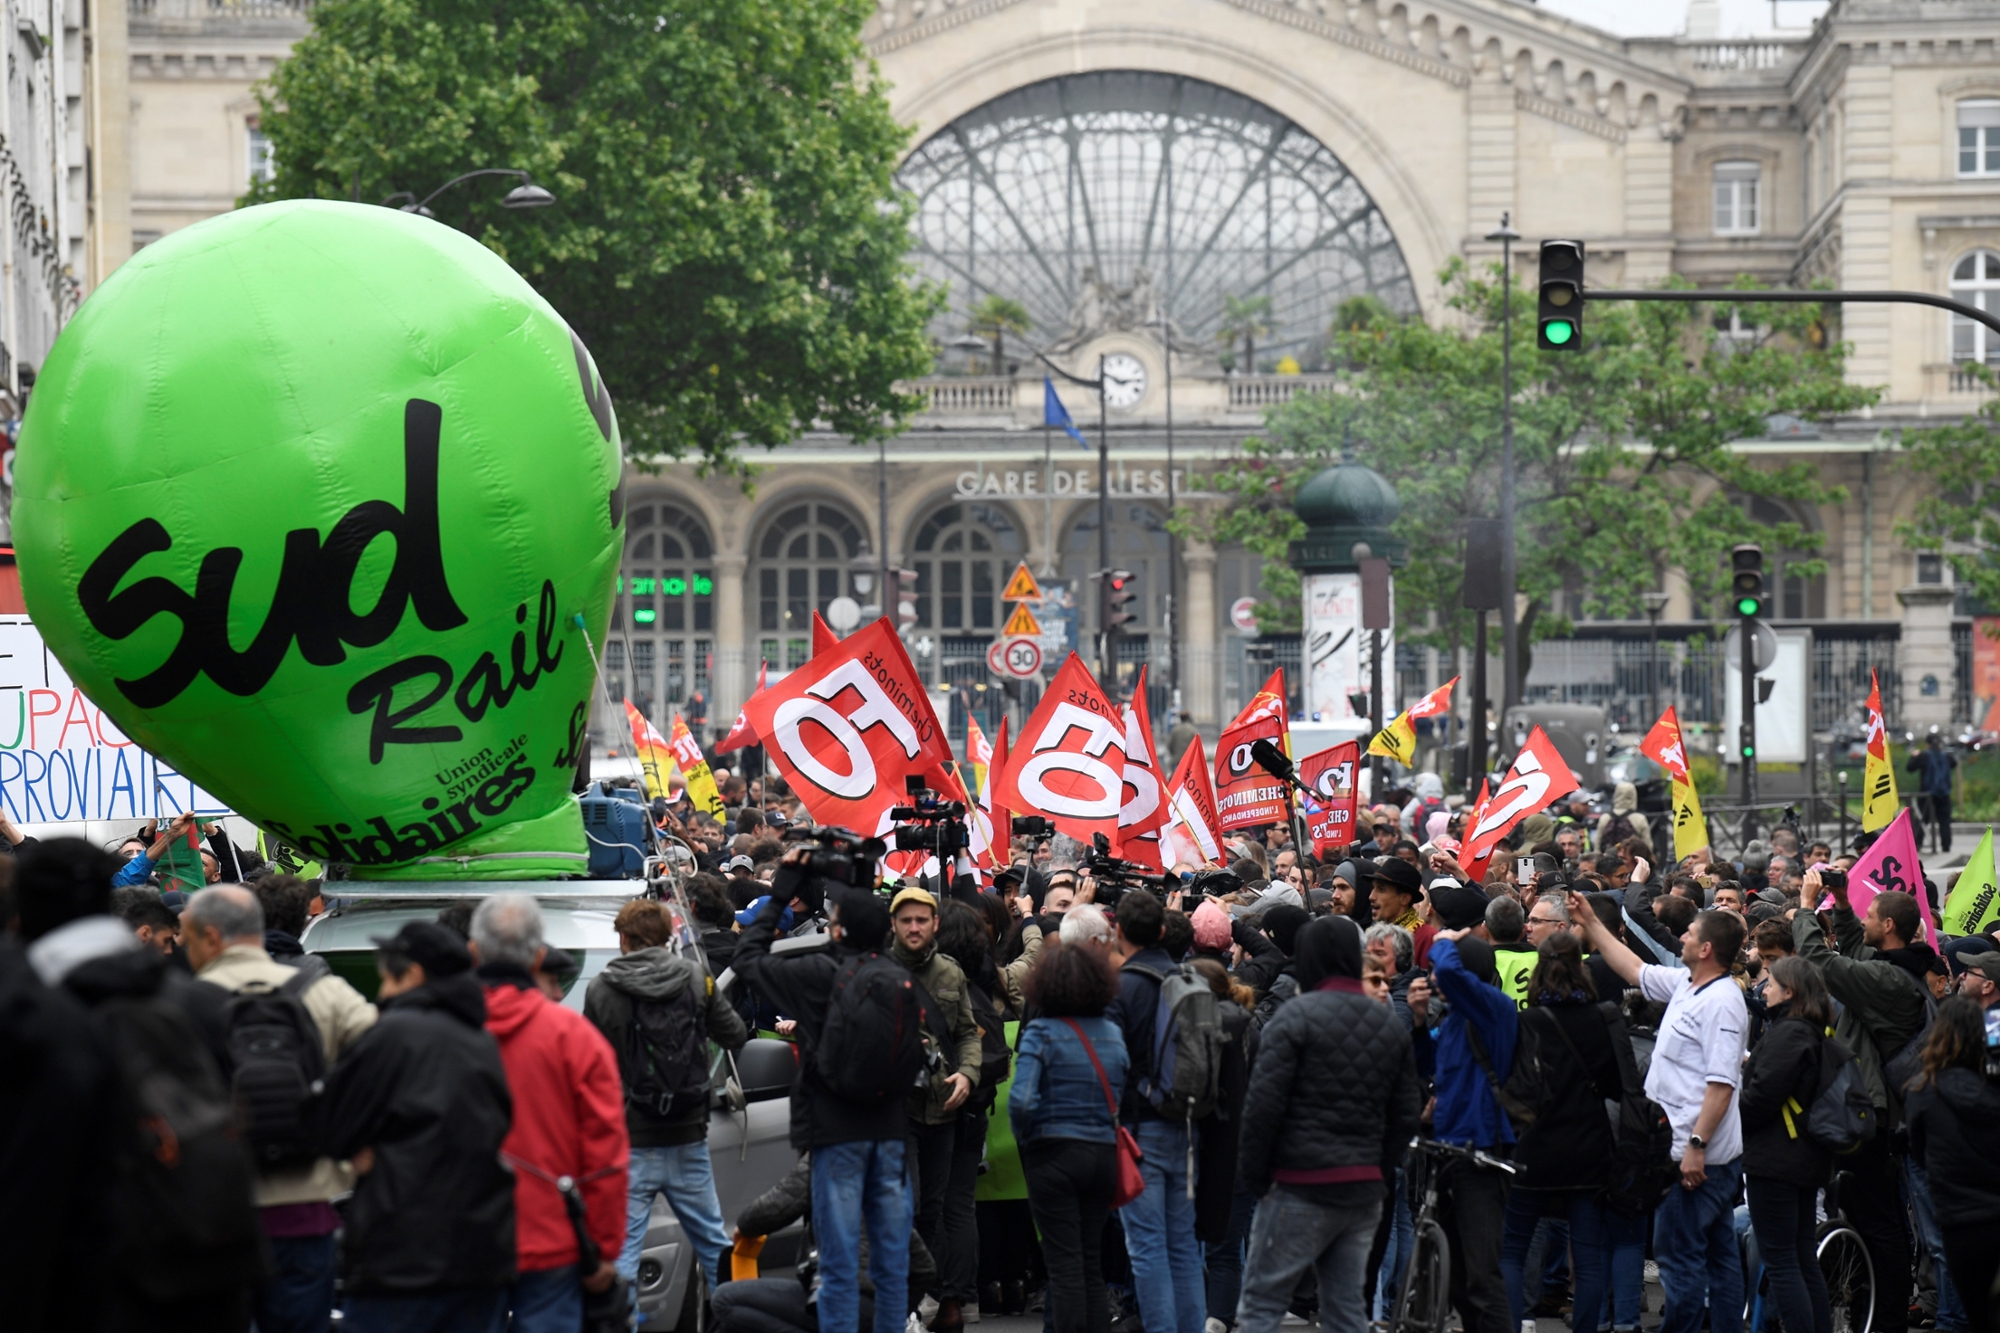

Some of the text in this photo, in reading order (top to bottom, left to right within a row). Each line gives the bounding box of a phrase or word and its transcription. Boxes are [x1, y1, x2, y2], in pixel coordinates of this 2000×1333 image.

[956, 470, 1038, 496] GARE
[1053, 470, 1091, 495] DE
[347, 578, 564, 765] Rail
[1012, 649, 1034, 667] 30
[29, 688, 135, 750] PAC
[435, 747, 493, 786] Union
[446, 733, 529, 800] syndicale
